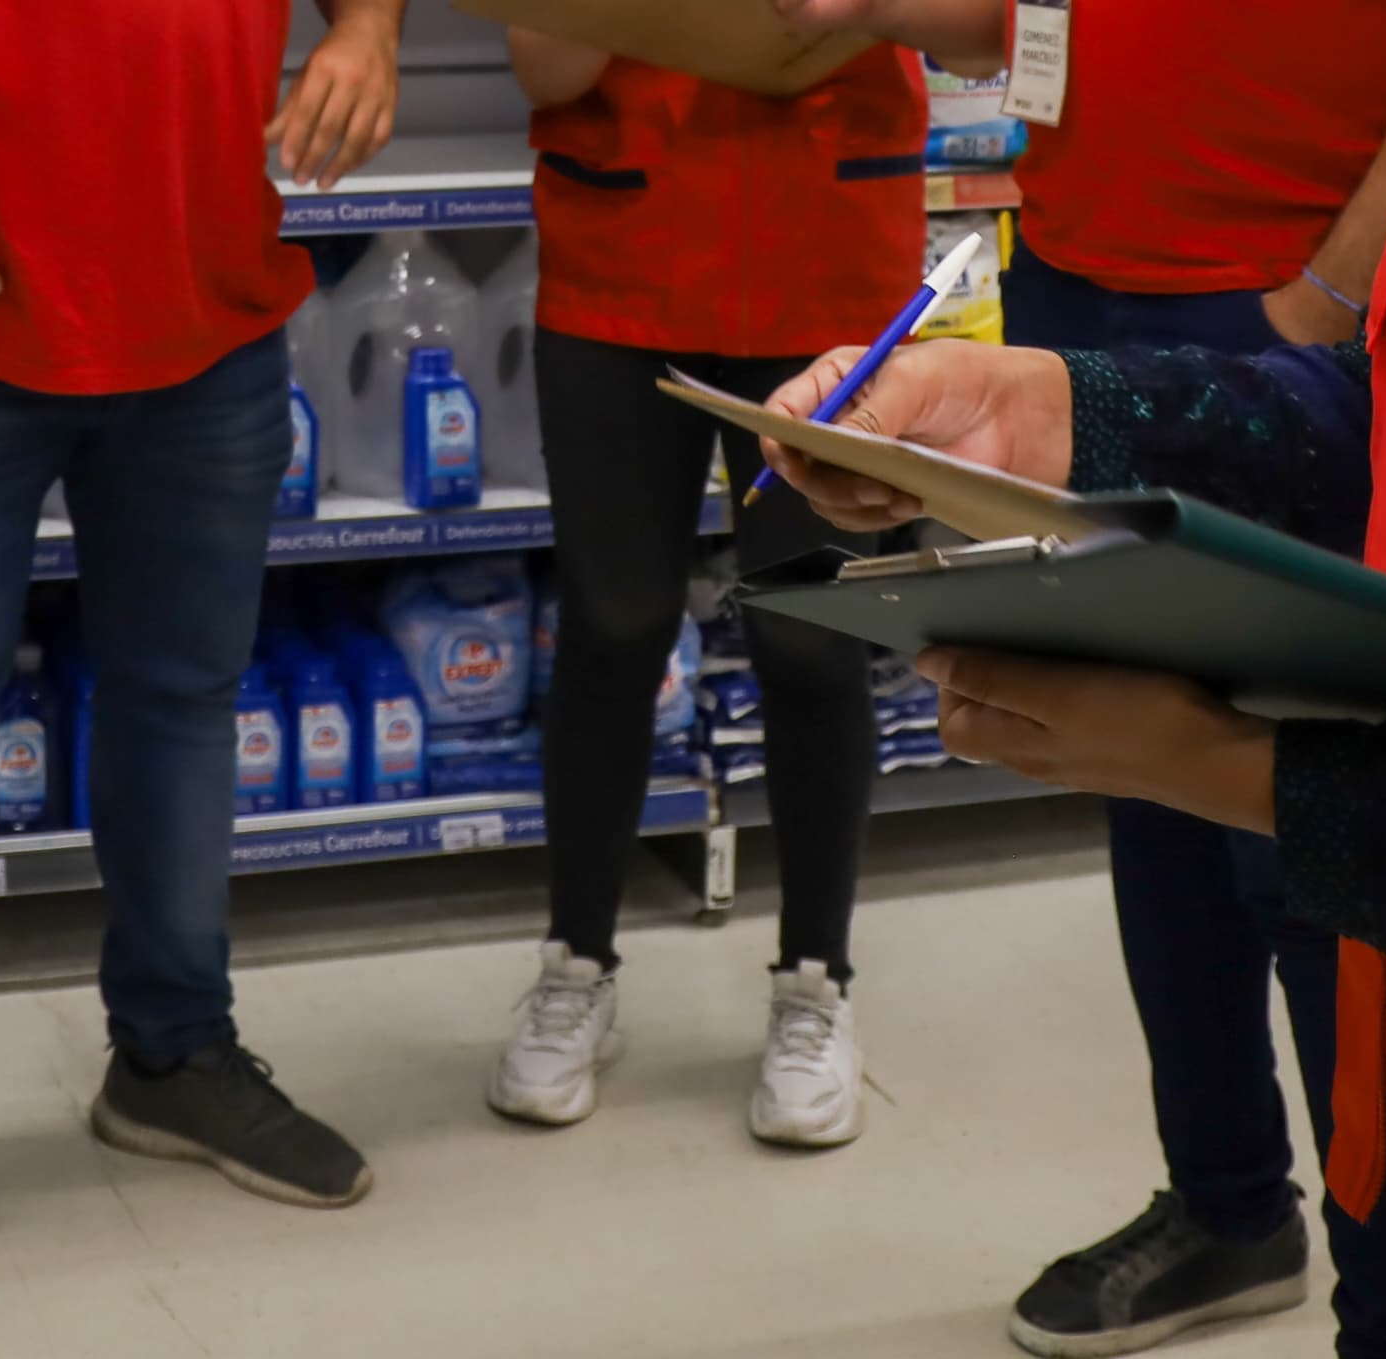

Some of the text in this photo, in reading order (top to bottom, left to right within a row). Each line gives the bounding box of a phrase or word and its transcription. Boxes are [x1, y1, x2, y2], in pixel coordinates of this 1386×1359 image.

[338, 201, 425, 222] Carrefour
[338, 527, 425, 548] Carrefour
[324, 827, 410, 850] Carrefour
